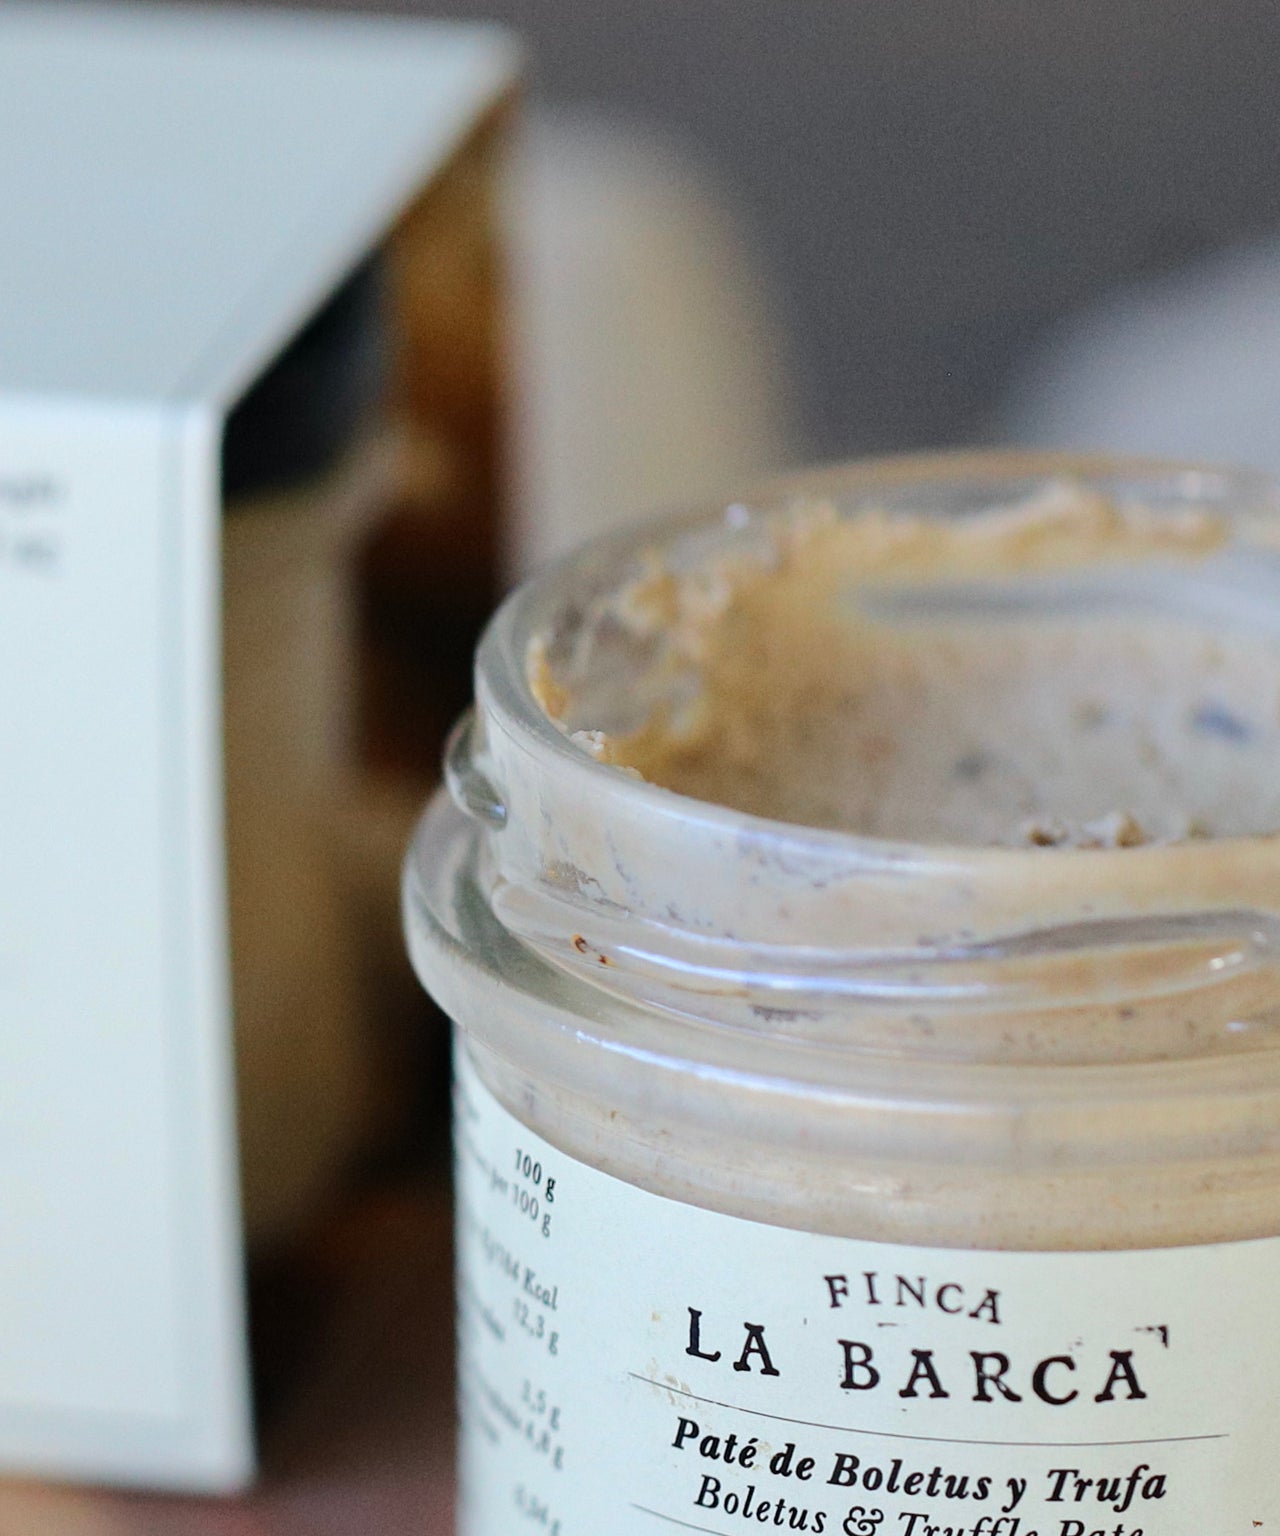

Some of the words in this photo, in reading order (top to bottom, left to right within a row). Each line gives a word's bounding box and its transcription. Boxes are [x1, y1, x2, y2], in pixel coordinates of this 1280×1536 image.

[514, 1149, 543, 1186] 100
[545, 1177, 557, 1203] g
[523, 1266, 559, 1311] Kcal
[825, 1272, 1003, 1324] FINCA
[685, 1307, 780, 1376] LA
[839, 1340, 1148, 1405] BARCA
[671, 1417, 760, 1469] Paté
[769, 1443, 814, 1480] de
[826, 1453, 992, 1502] Boletus
[1006, 1477, 1028, 1514] y
[1045, 1465, 1168, 1514] Trufa
[694, 1474, 828, 1535] Boletus
